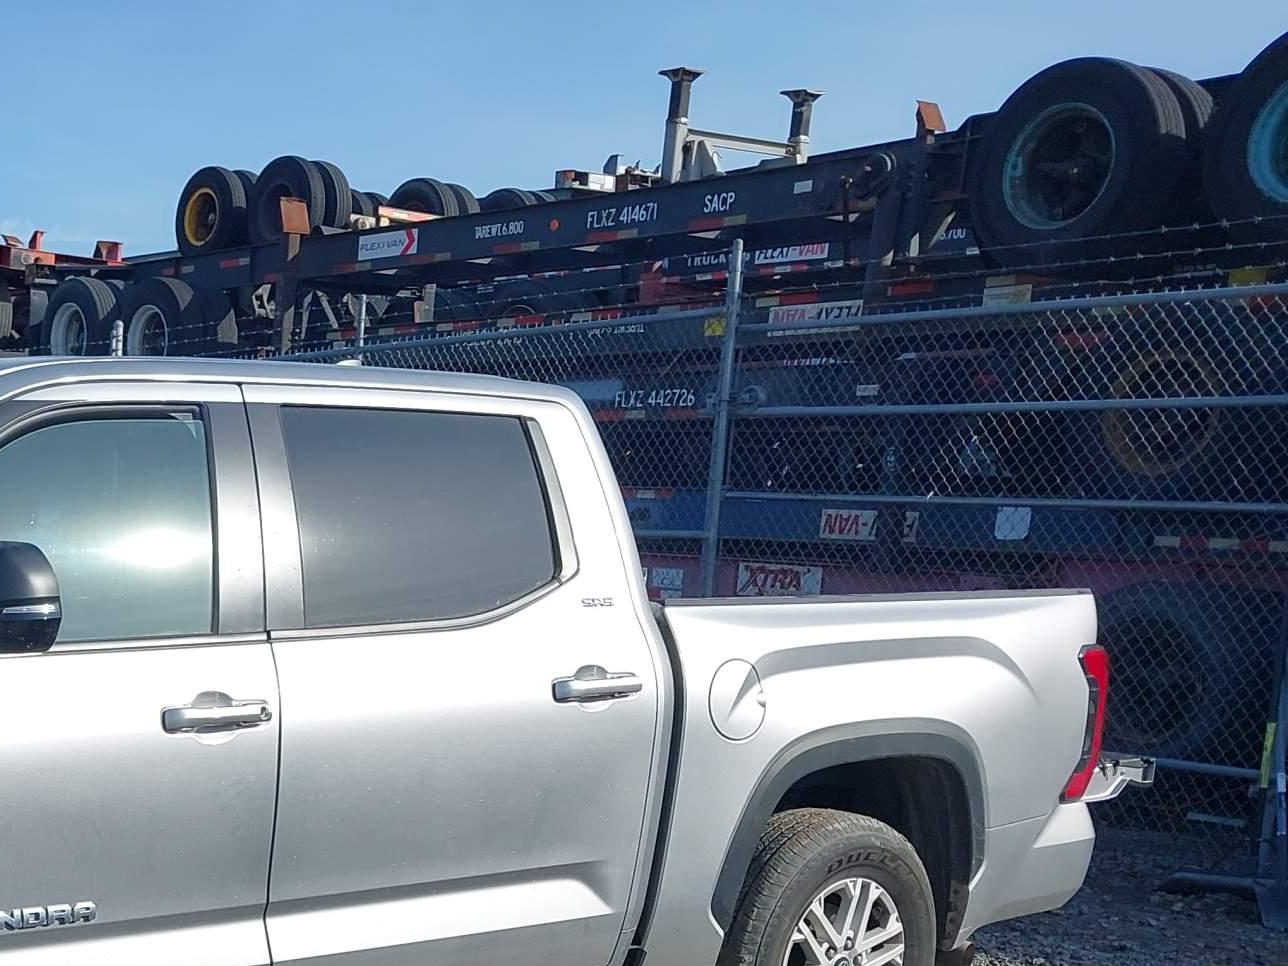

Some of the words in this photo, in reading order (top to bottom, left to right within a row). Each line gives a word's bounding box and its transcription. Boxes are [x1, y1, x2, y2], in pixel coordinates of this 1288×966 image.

[703, 192, 735, 214] SACP
[586, 208, 616, 229] FLXZ
[618, 202, 658, 225] 414671
[614, 390, 645, 409] FLXZ
[647, 388, 696, 408] 442726
